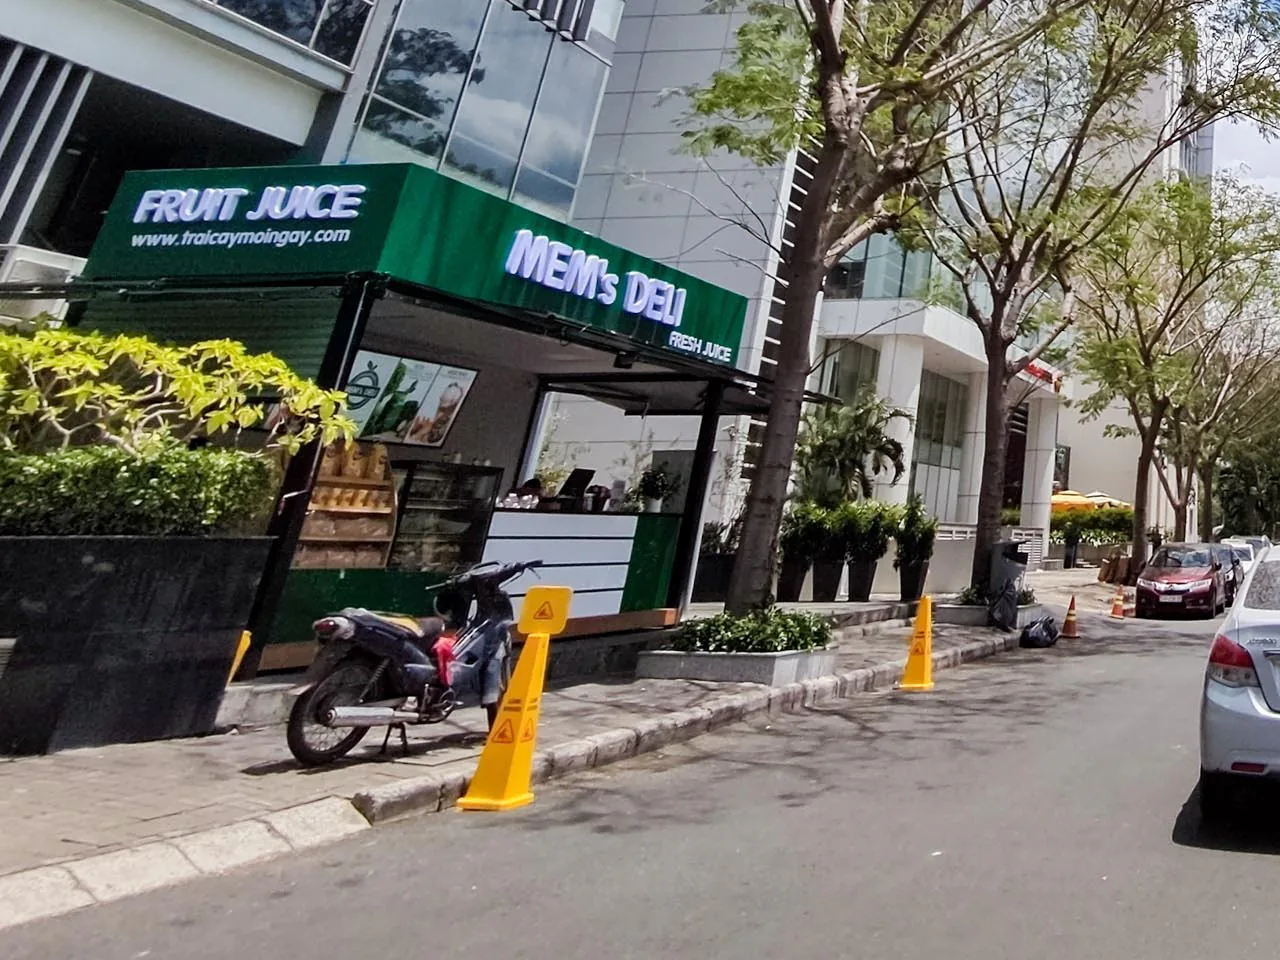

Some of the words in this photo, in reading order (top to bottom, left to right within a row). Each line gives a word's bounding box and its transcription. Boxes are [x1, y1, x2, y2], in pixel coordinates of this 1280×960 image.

[132, 188, 248, 224] FRUIT
[245, 184, 367, 221] JUICE
[131, 228, 350, 249] www.traicaymoingay.com
[505, 228, 619, 306] MEM's
[623, 270, 687, 327] DELI
[668, 330, 703, 353] FRESH
[702, 343, 732, 363] JUICE
